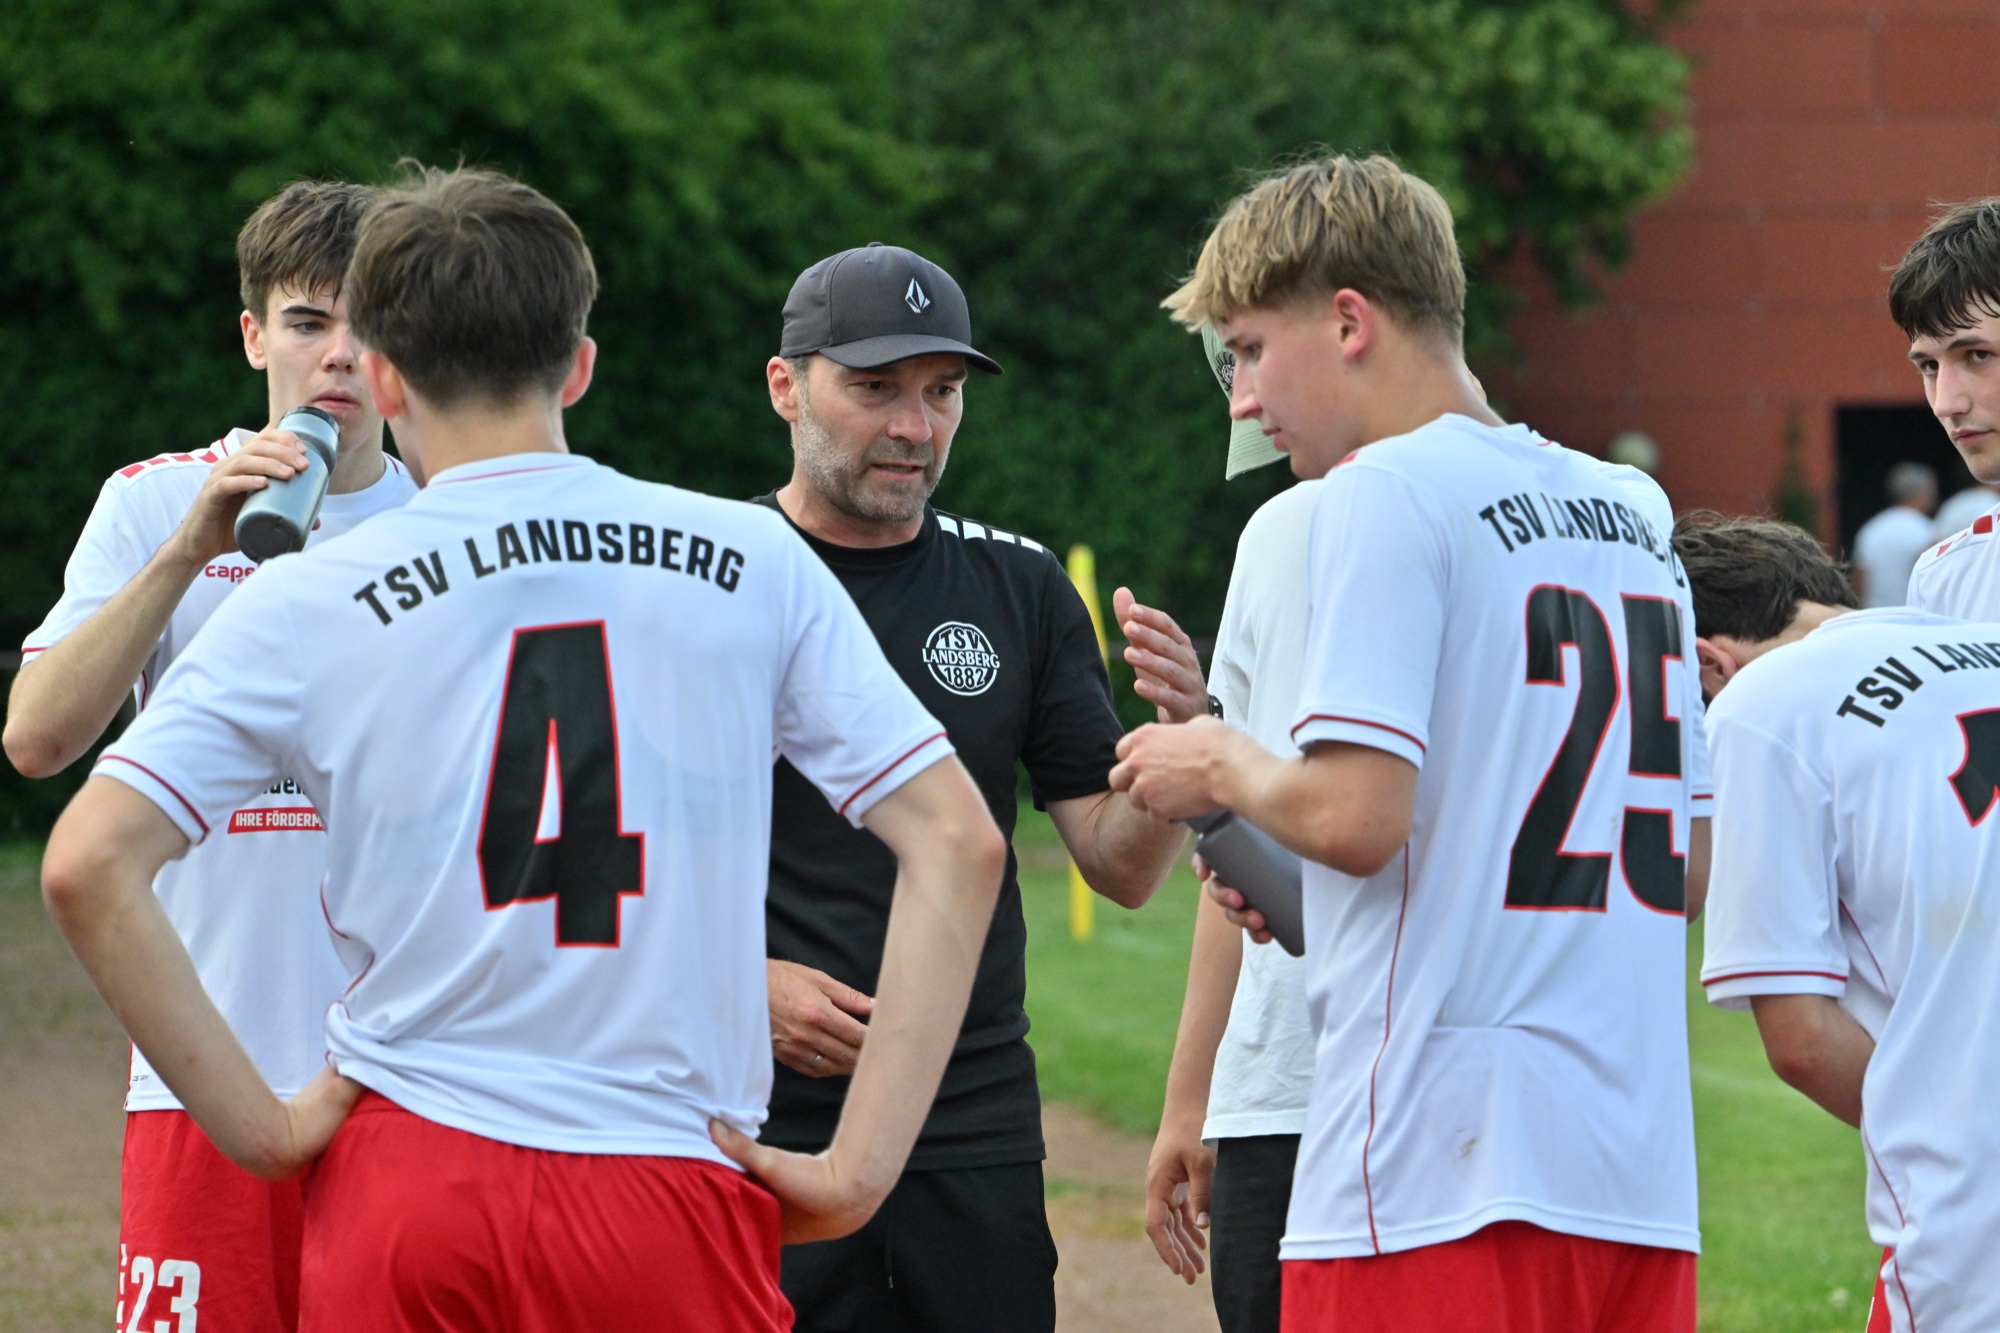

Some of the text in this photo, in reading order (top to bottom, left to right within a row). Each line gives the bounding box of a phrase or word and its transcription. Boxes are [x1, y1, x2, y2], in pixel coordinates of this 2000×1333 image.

[1479, 493, 1546, 553] TSV
[353, 519, 744, 626] TSV LANDSBERG
[922, 648, 1000, 668] LANDSBERG
[939, 627, 980, 650] TSV
[944, 667, 985, 689] 1882
[1836, 656, 1924, 728] TSV
[1503, 583, 1685, 915] 25
[476, 619, 645, 948] 4
[235, 813, 264, 827] IHRE
[126, 1255, 201, 1333] 23
